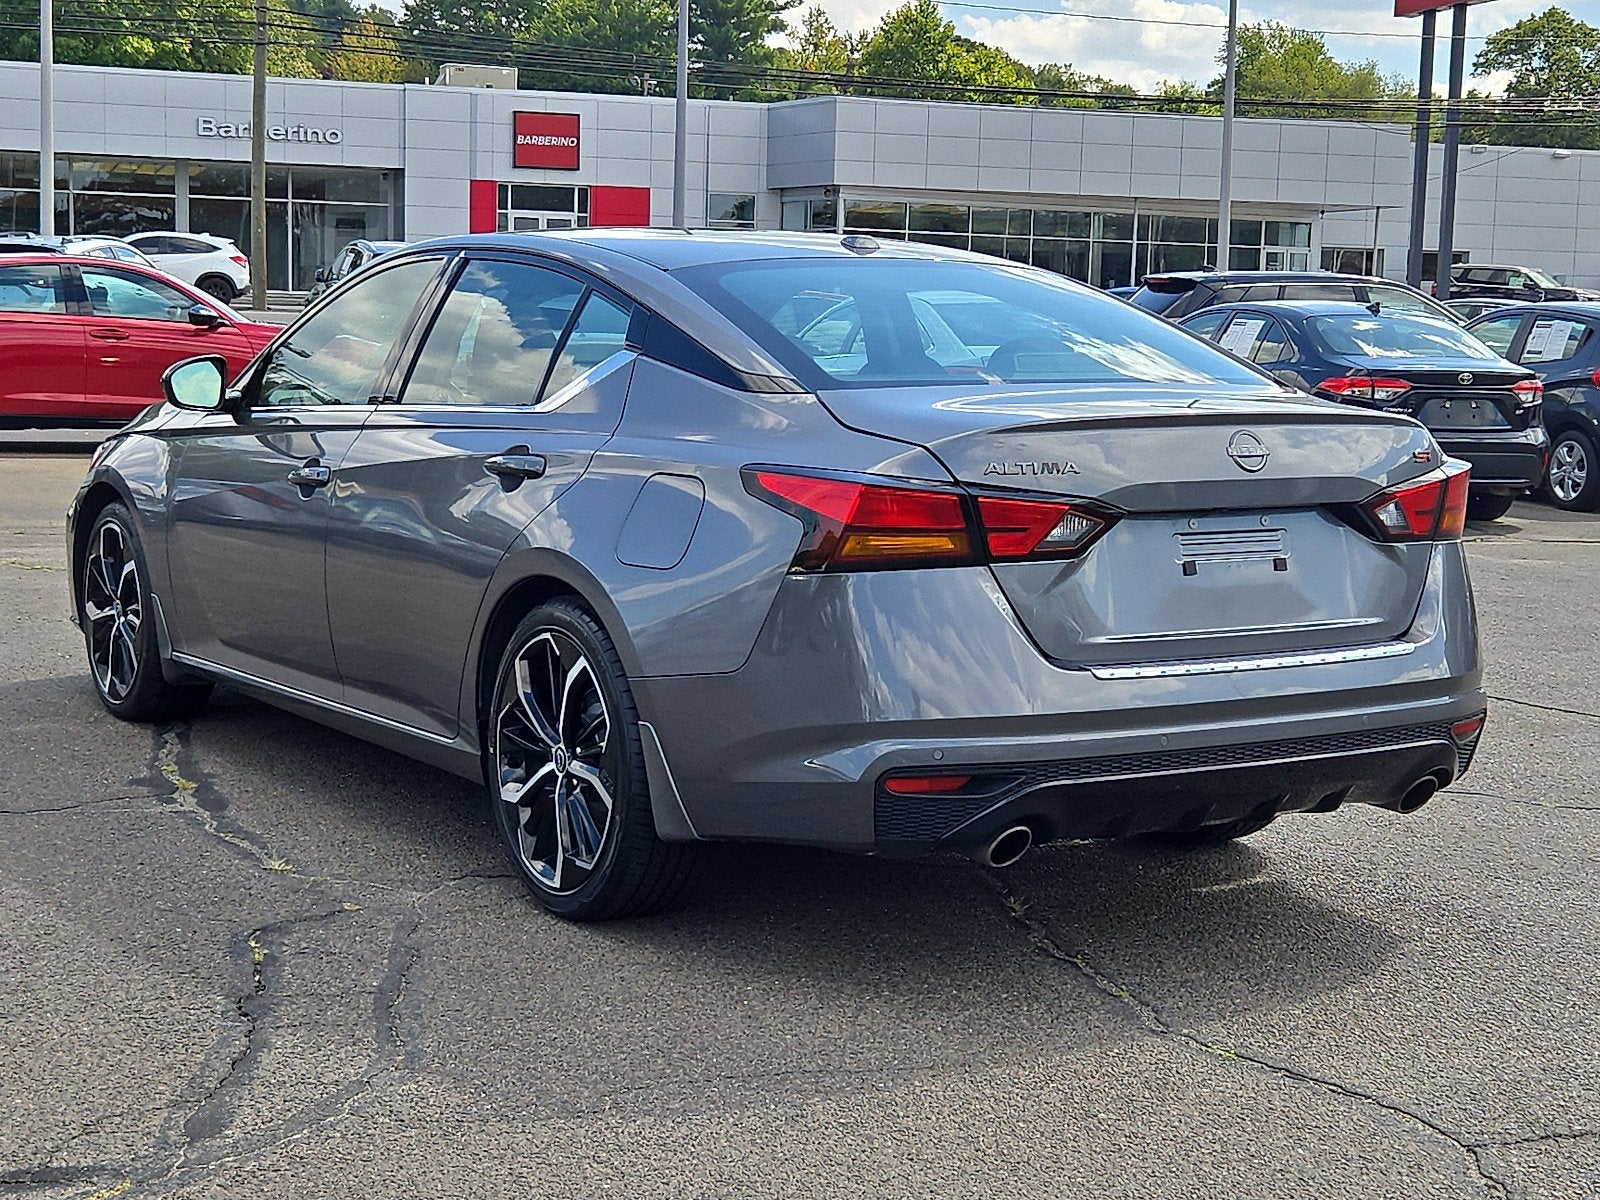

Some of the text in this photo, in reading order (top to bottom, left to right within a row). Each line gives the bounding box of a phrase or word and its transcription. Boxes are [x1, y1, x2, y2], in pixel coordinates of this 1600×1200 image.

[197, 115, 343, 143] Barerino
[516, 134, 578, 147] BARBERINO
[983, 461, 1081, 476] ALTIMA
